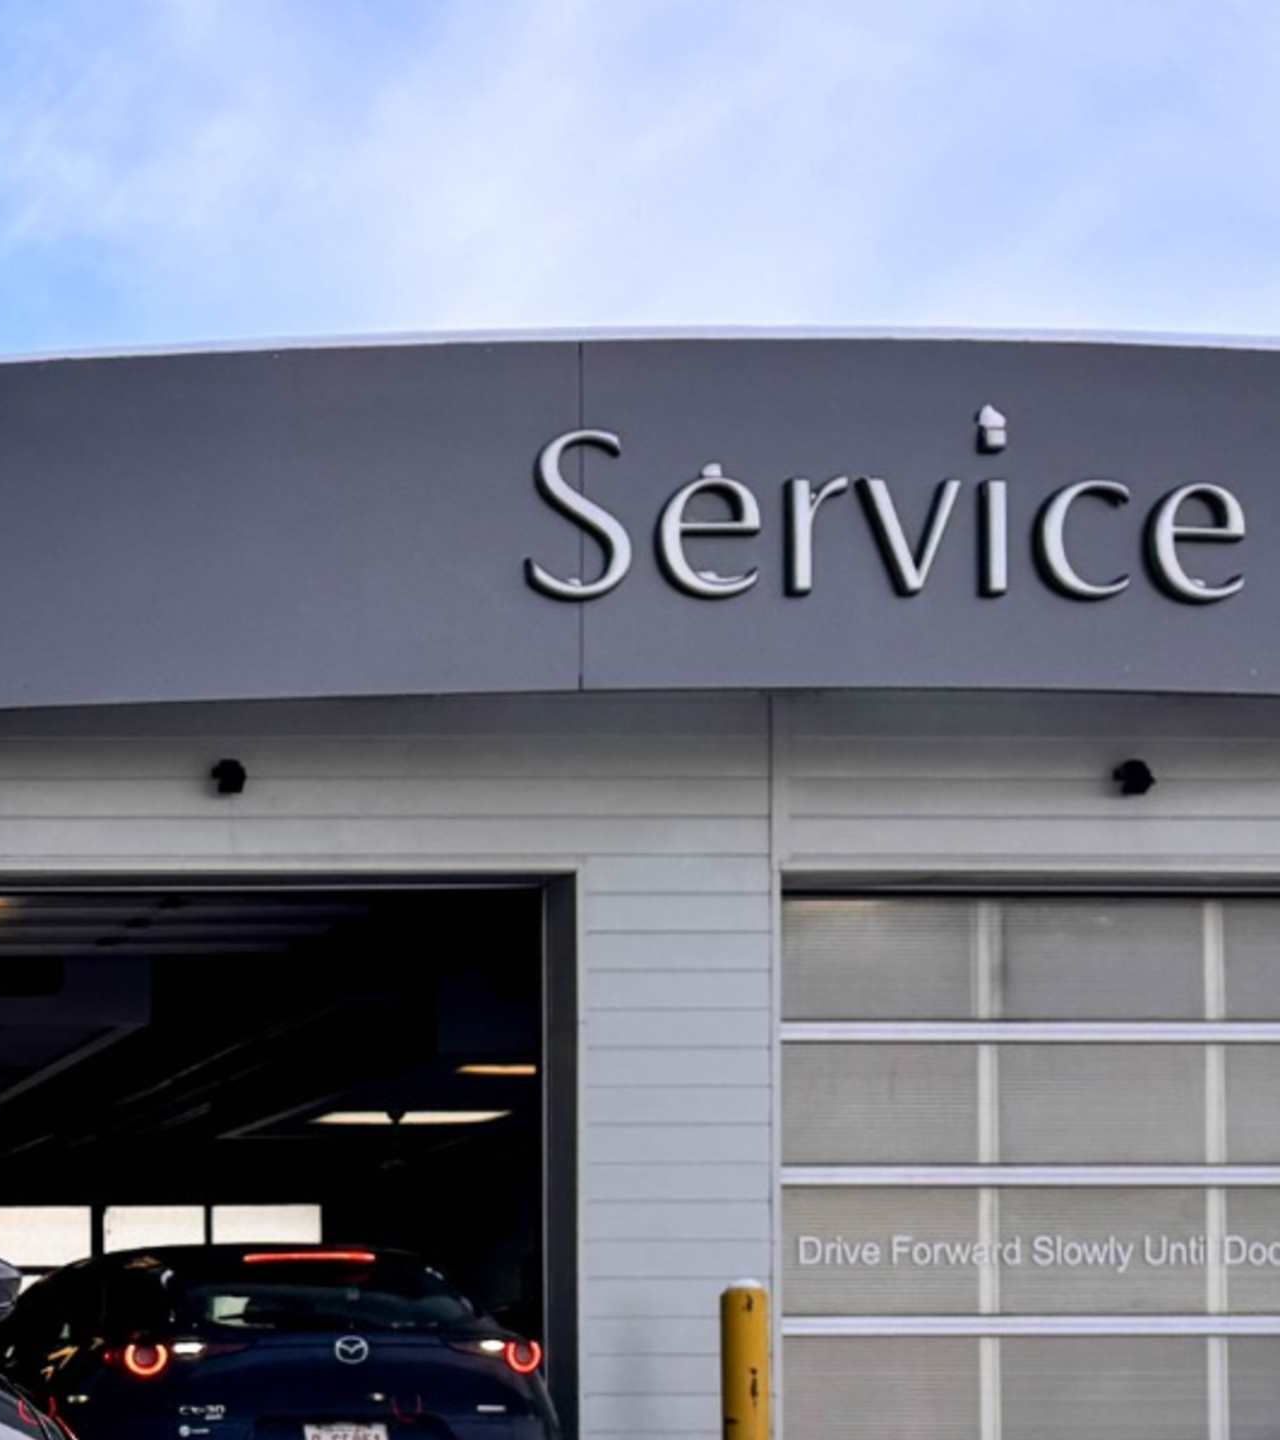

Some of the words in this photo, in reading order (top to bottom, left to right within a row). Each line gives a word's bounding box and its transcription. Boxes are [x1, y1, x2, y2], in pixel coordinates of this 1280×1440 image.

[524, 425, 1246, 602] Service
[798, 1235, 881, 1265] Drive
[892, 1234, 1022, 1265] Forward
[1032, 1234, 1133, 1273] Slowly
